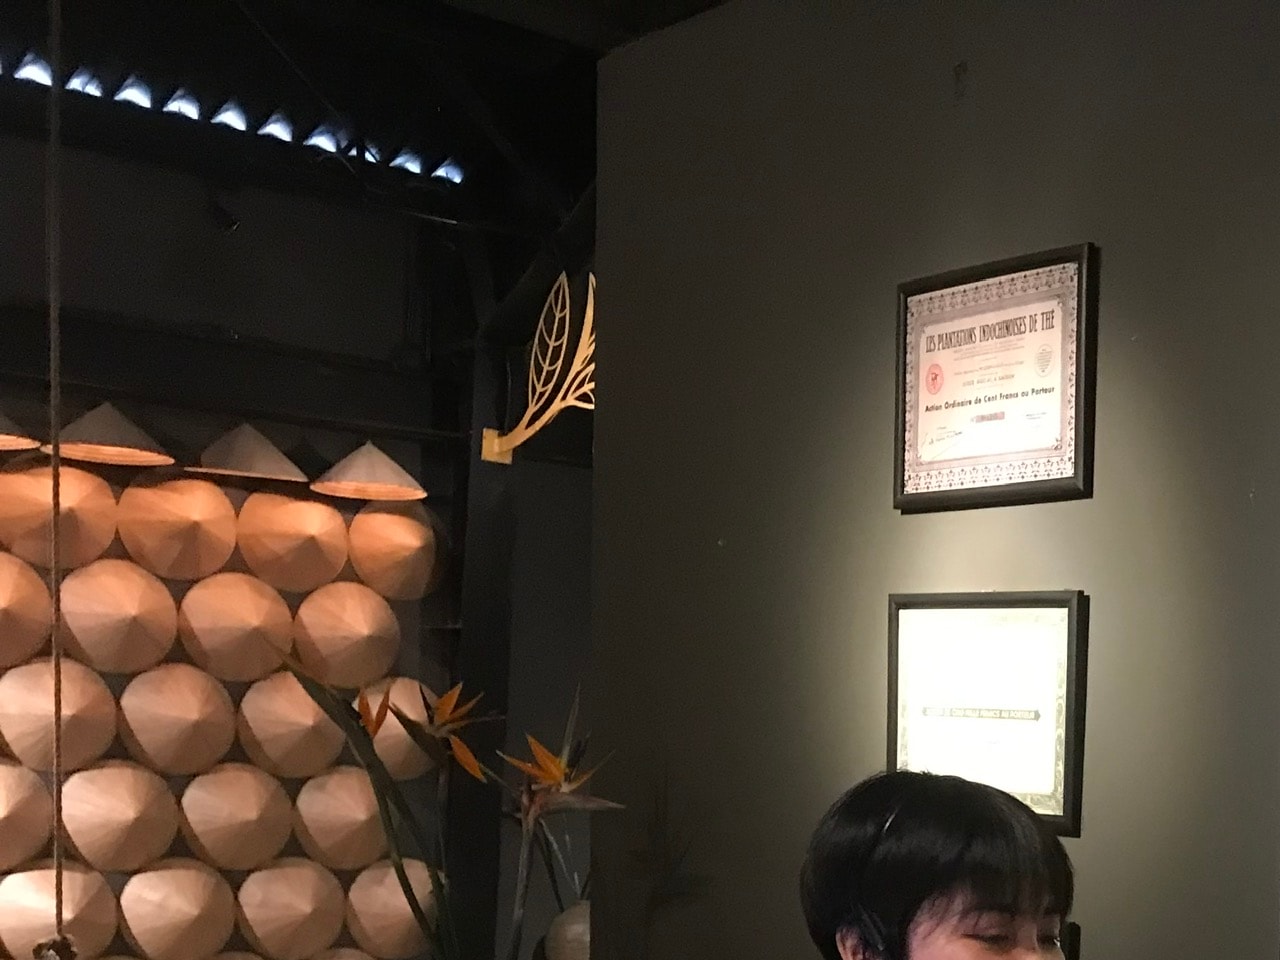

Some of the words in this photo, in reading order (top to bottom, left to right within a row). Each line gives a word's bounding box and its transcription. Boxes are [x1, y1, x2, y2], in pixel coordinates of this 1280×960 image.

[925, 336, 936, 353] LES
[937, 327, 976, 352] PLANTATIONS
[979, 316, 1027, 342] INDOCHINOISES
[1028, 313, 1038, 333] DE
[925, 404, 942, 413] Action
[944, 398, 972, 410] Ordinaire
[974, 396, 982, 405] de
[983, 394, 998, 403] Cent
[999, 391, 1019, 401] Francs
[1031, 386, 1055, 396] Porteur
